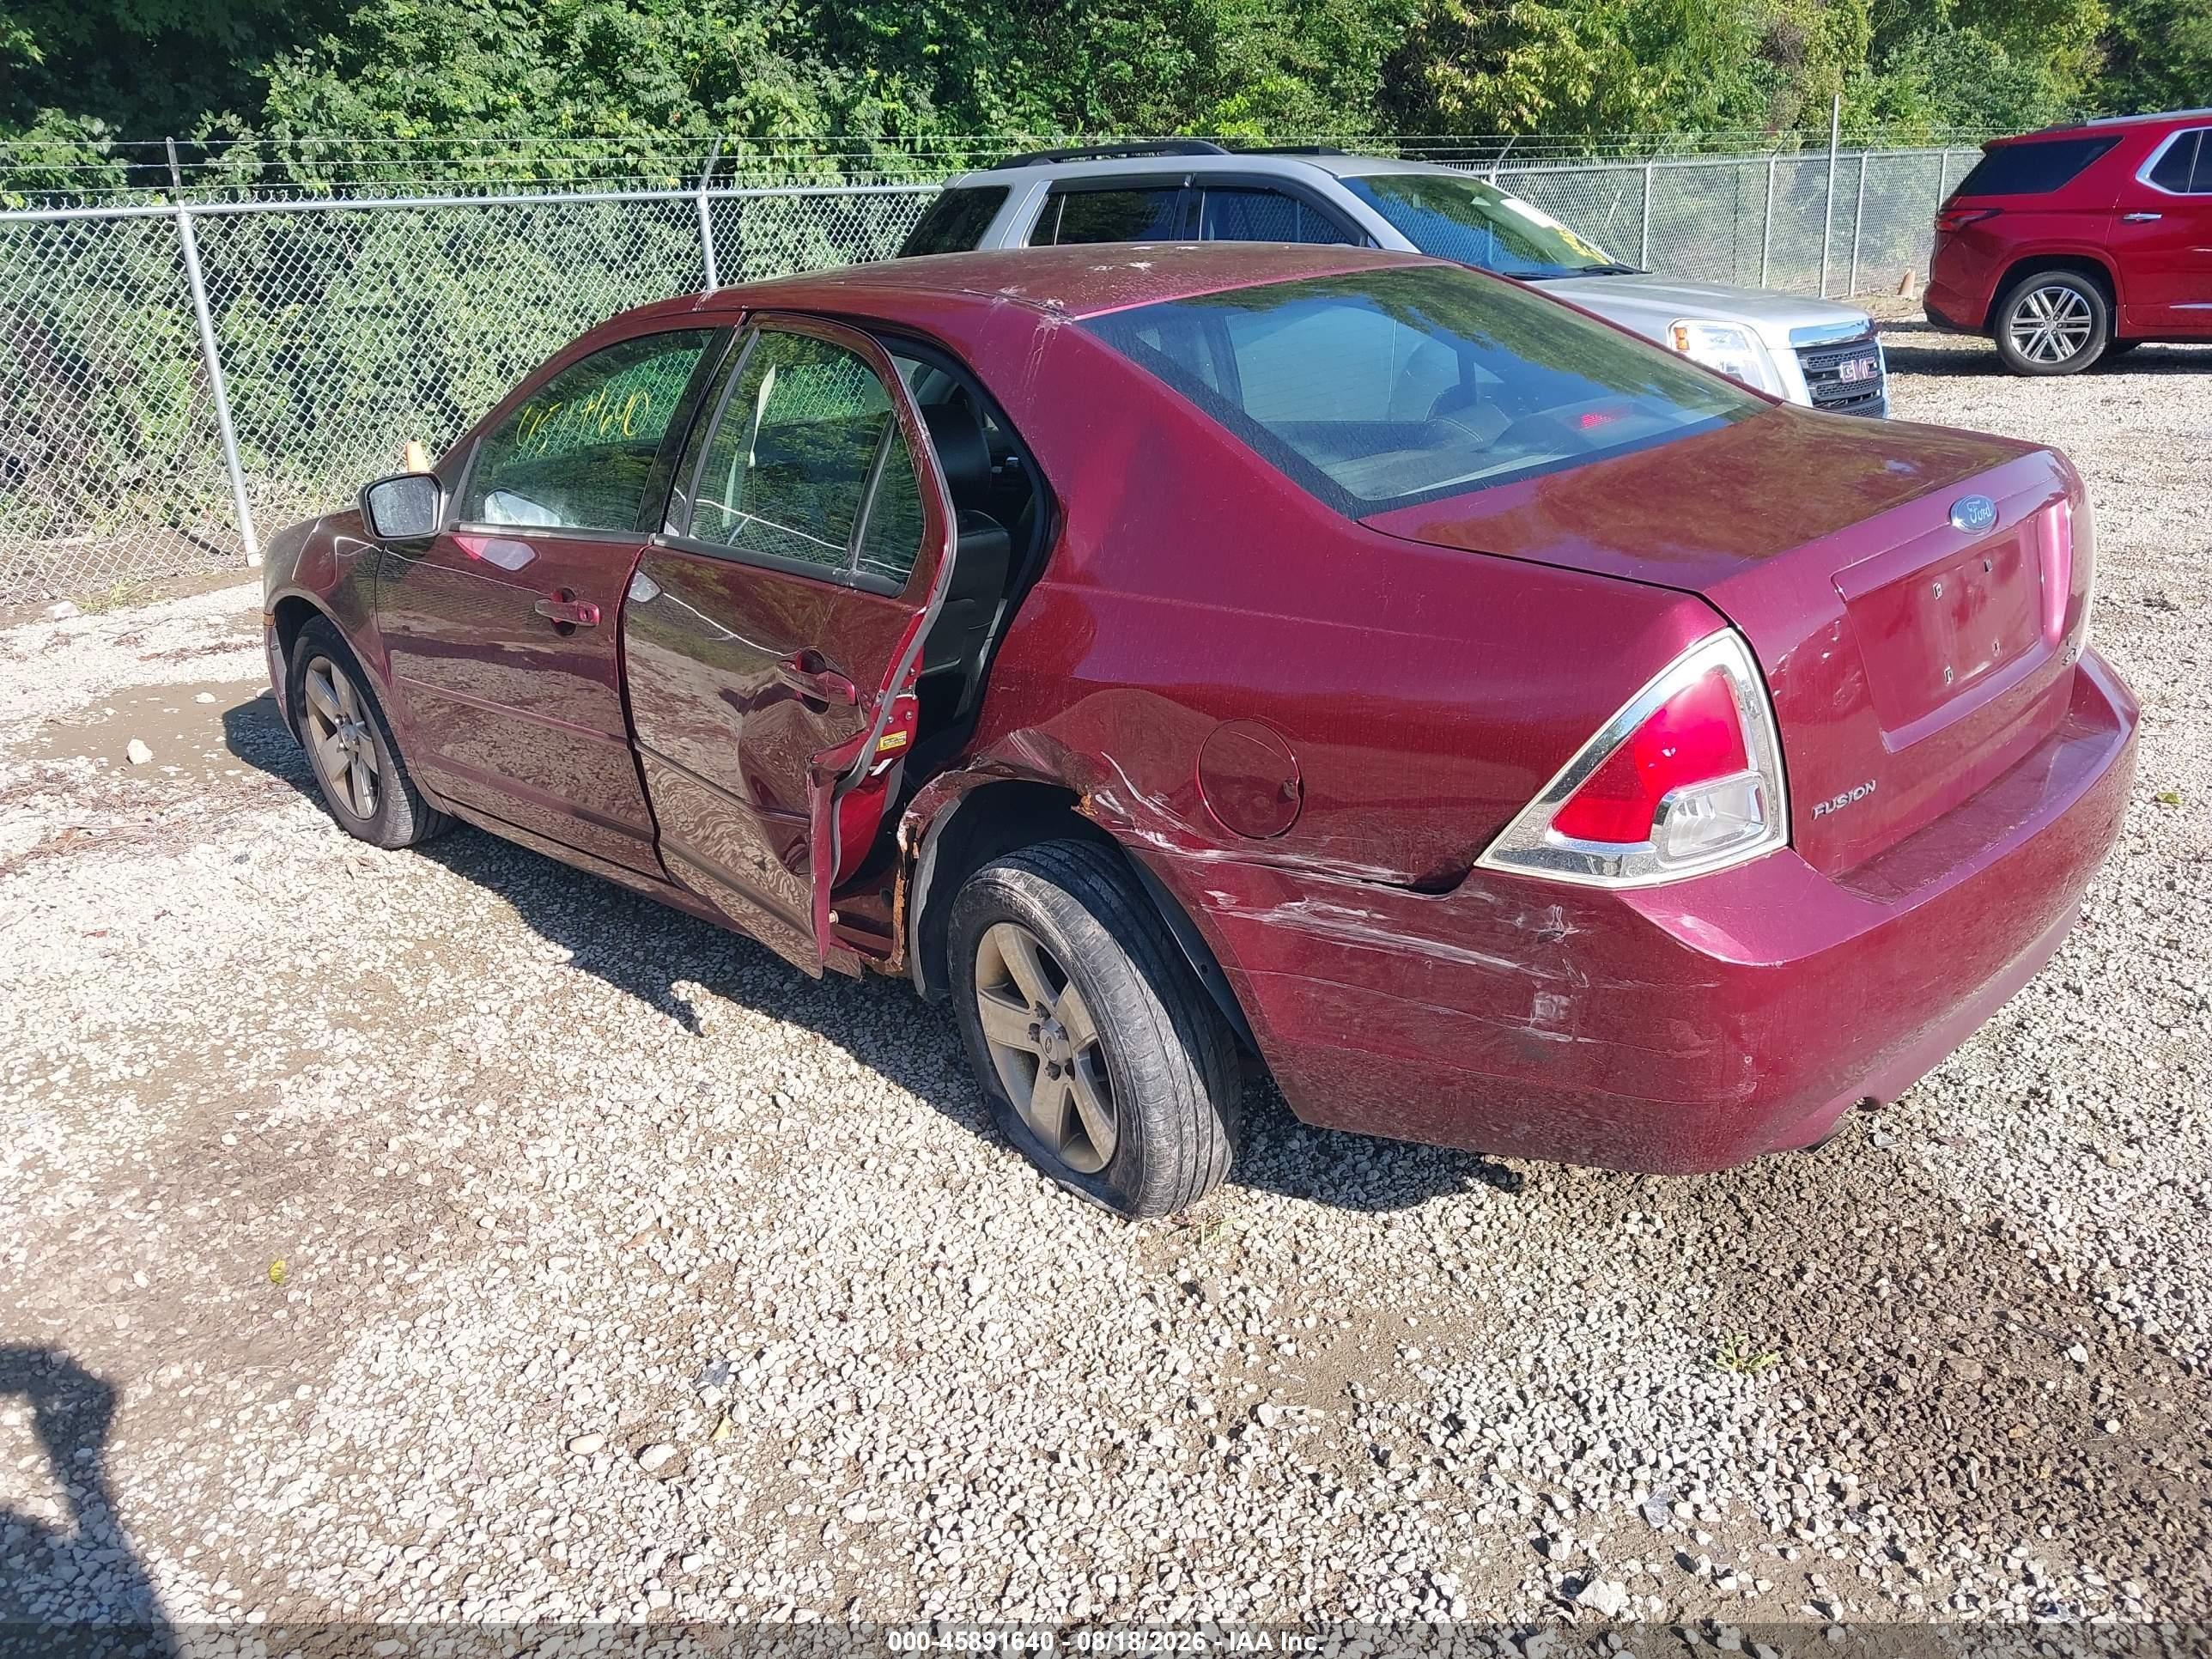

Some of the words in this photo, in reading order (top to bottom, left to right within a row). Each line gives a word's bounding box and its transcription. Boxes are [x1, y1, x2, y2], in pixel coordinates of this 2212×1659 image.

[1839, 356, 1878, 385] GMC
[1966, 499, 1992, 524] Ford
[1811, 778, 1876, 821] FUSION
